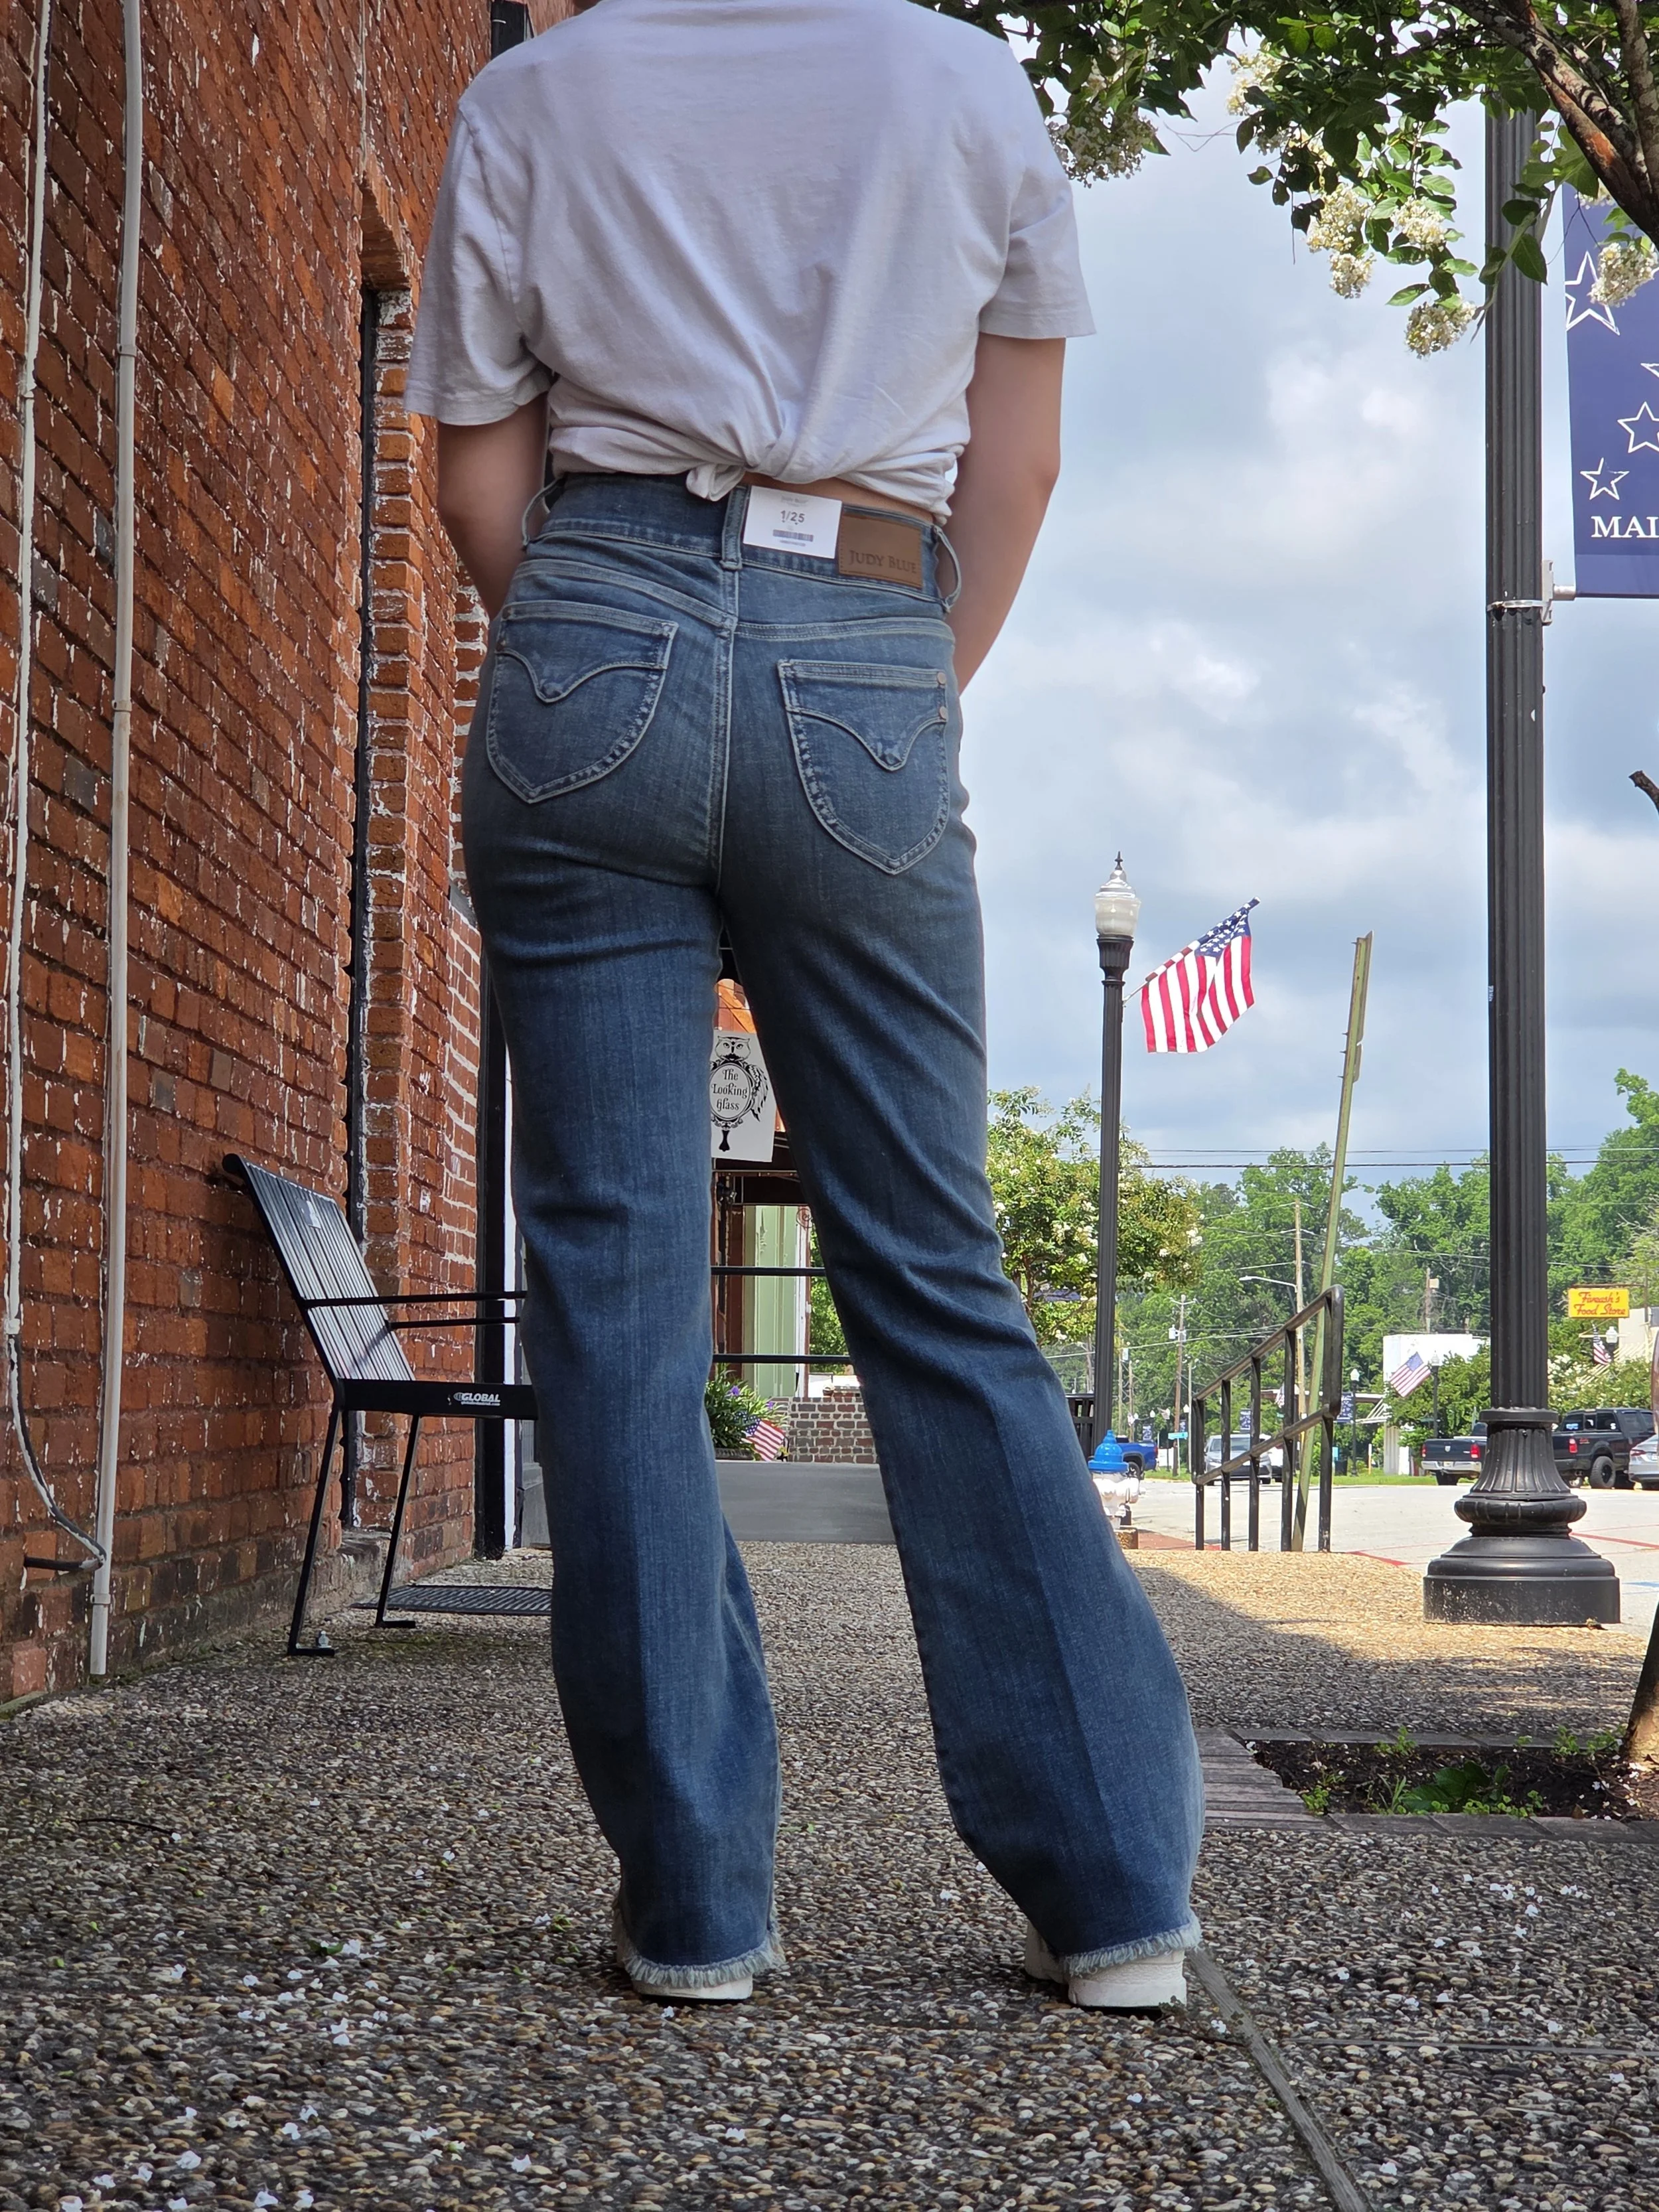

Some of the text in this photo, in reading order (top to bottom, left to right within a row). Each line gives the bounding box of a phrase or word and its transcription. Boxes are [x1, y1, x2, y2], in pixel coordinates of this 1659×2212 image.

[780, 510, 806, 523] 1/25
[849, 550, 917, 573] JUDY BLUE
[722, 1069, 739, 1080] The
[711, 1083, 747, 1099] Looking
[716, 1098, 739, 1112] Glass
[1573, 1303, 1626, 1315] Food Store
[461, 1392, 501, 1402] GLOBAL
